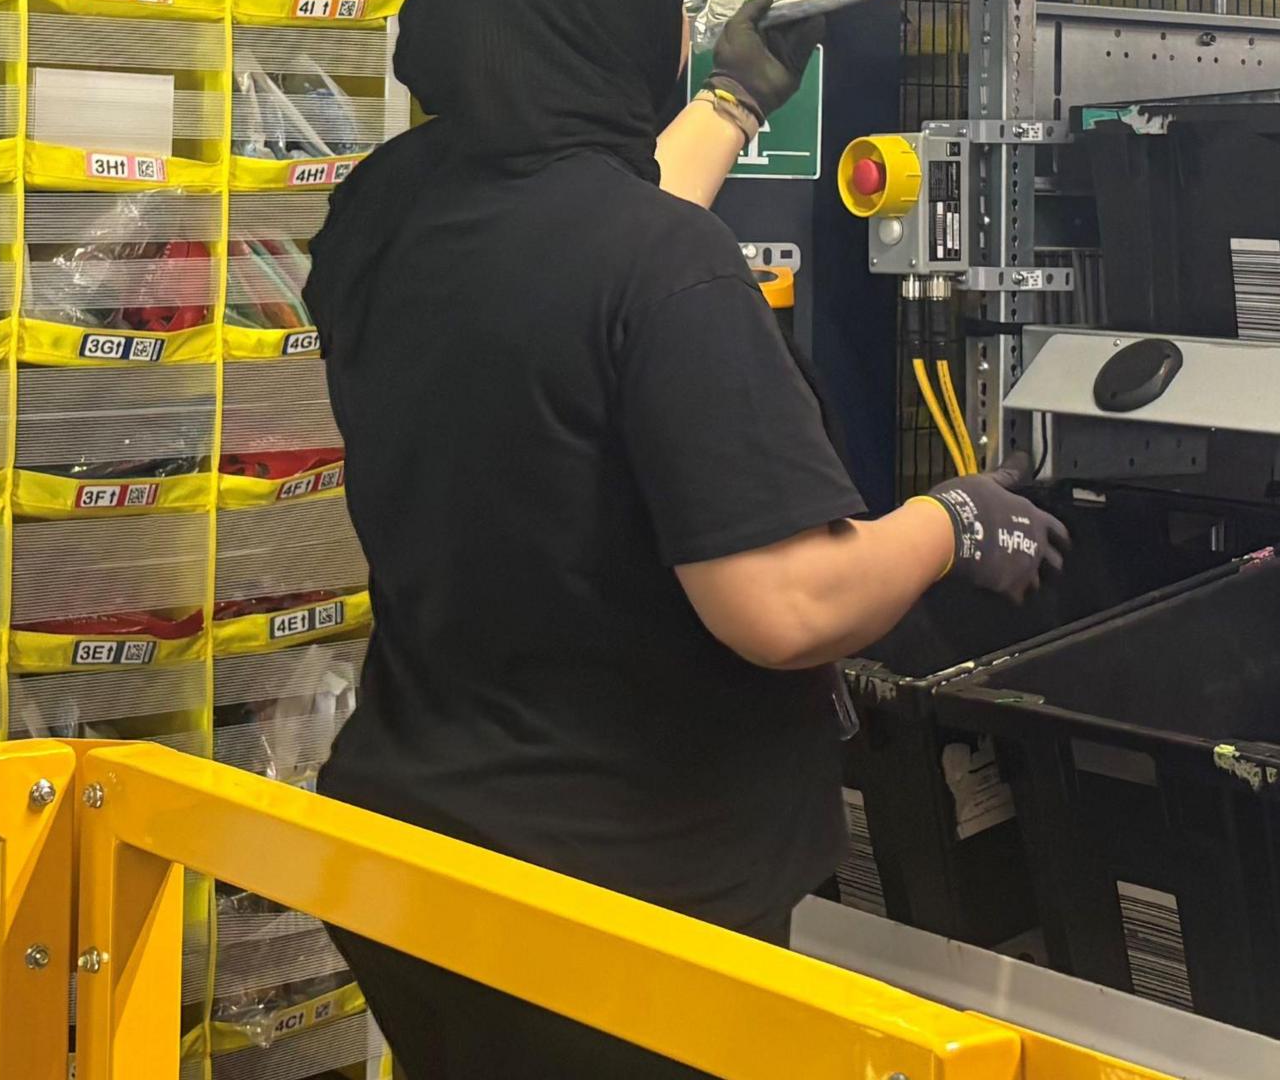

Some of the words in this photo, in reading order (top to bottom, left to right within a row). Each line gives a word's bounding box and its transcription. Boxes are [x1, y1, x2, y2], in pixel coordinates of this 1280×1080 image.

[95, 159, 119, 174] 3H
[296, 167, 320, 182] 4H
[88, 339, 114, 354] 3G
[290, 337, 311, 350] 4G
[283, 481, 302, 496] 4F
[83, 490, 105, 505] 3F
[998, 528, 1038, 557] HyFlex
[277, 617, 298, 633] 4E
[79, 644, 103, 660] 3E
